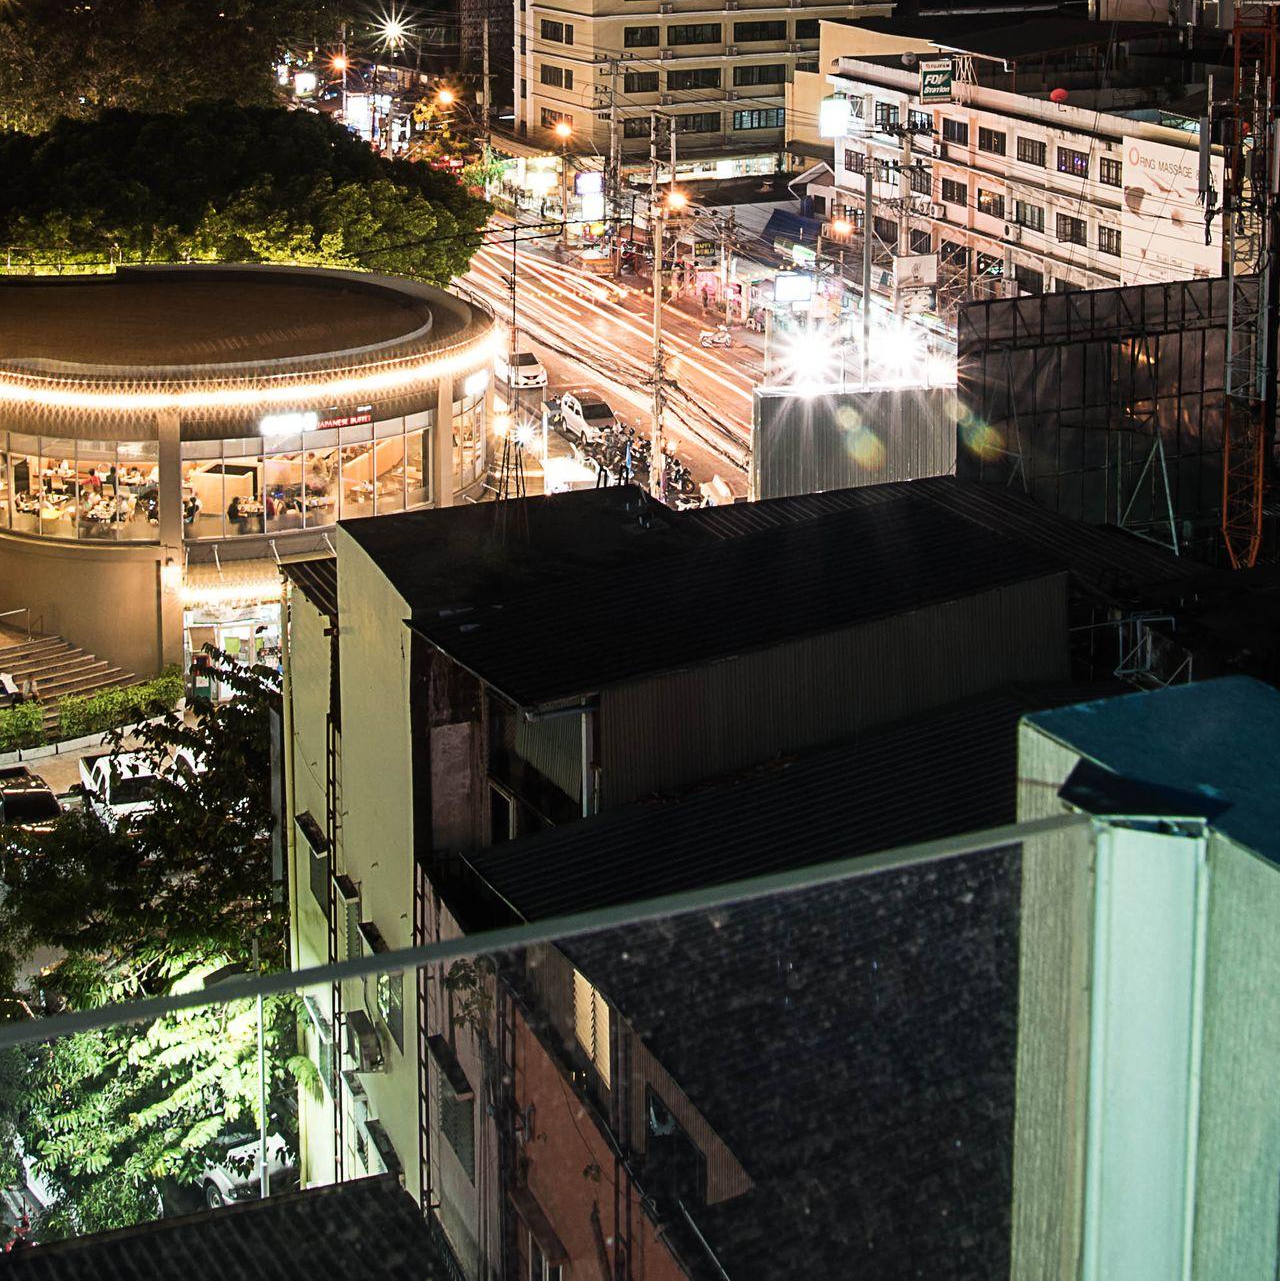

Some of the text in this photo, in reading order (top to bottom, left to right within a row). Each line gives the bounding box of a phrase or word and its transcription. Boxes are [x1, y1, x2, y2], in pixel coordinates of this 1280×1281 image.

[1158, 161, 1193, 178] MASSAGE
[317, 417, 349, 429] JAPANESE
[350, 415, 371, 424] BUFFET
